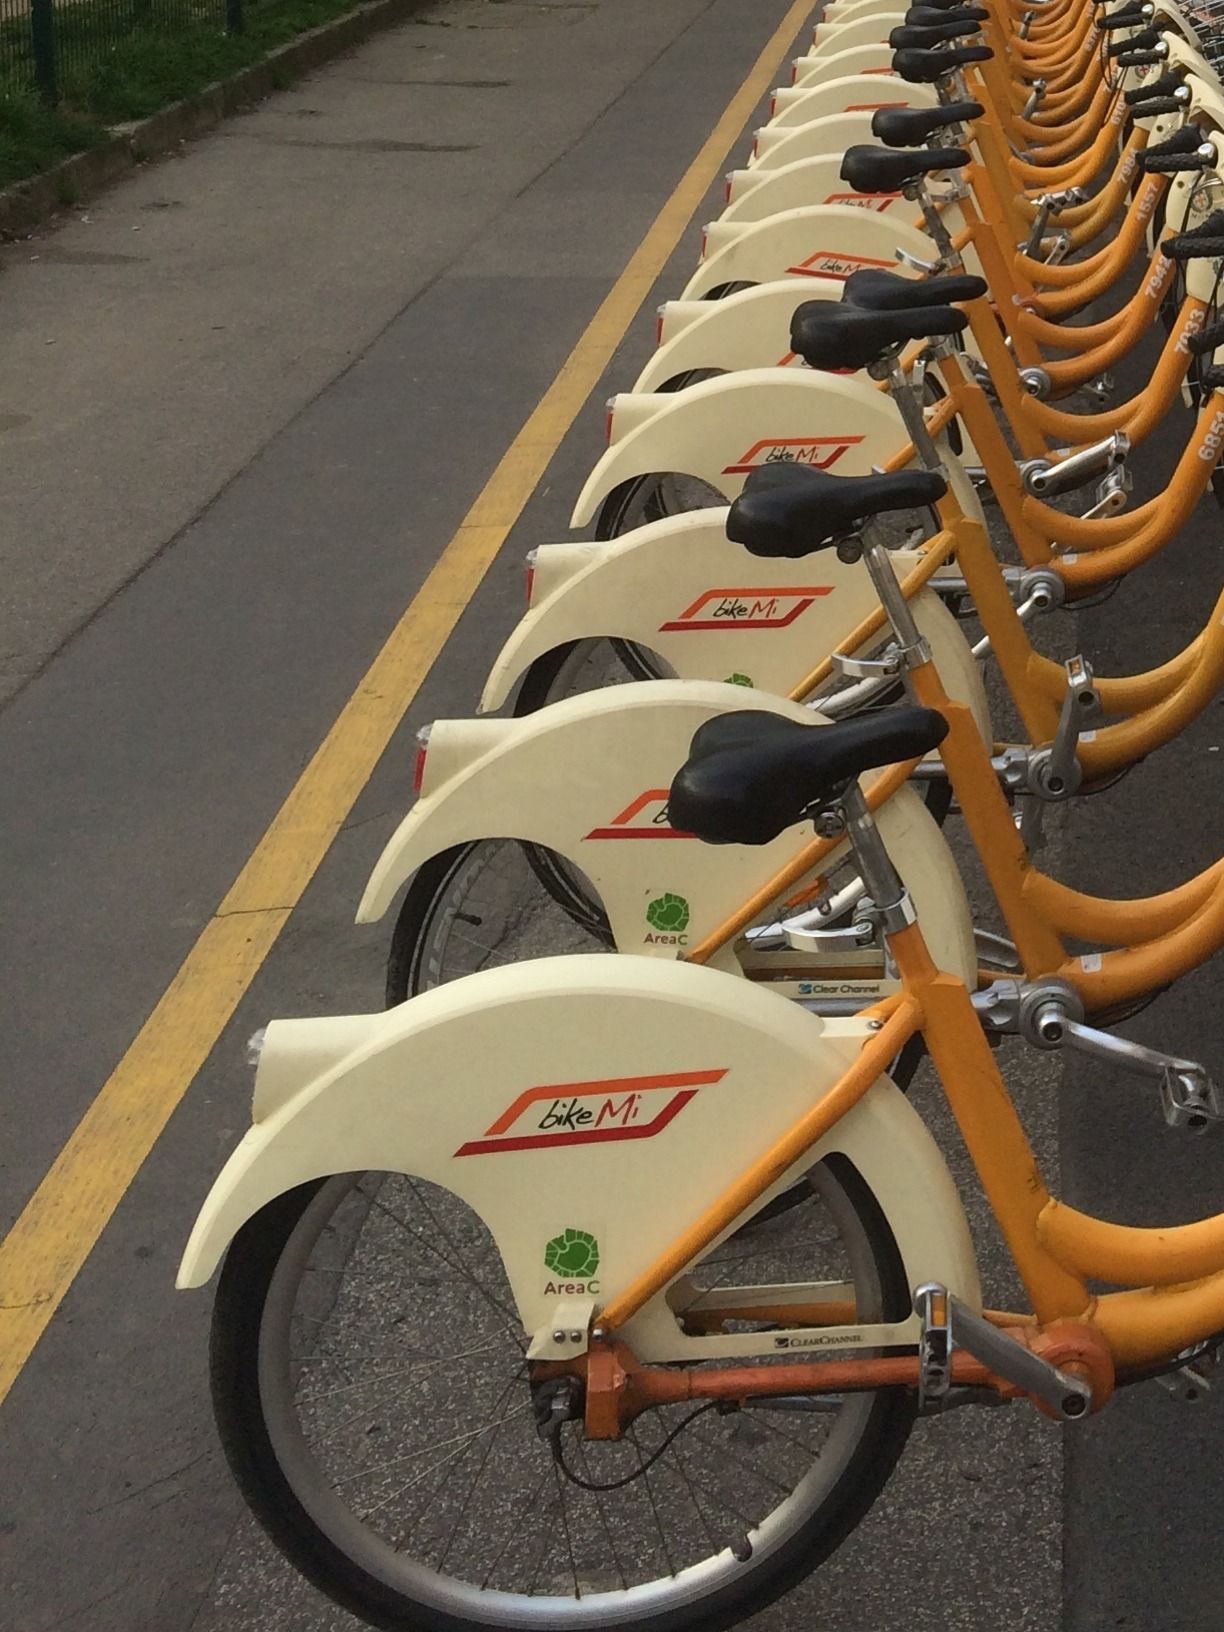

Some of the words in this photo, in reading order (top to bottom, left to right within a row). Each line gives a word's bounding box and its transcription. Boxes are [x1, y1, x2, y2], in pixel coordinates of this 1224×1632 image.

[712, 598, 780, 619] bikeMi
[813, 984, 840, 994] Clear
[840, 984, 880, 994] Channel
[538, 1093, 643, 1131] bikeMi
